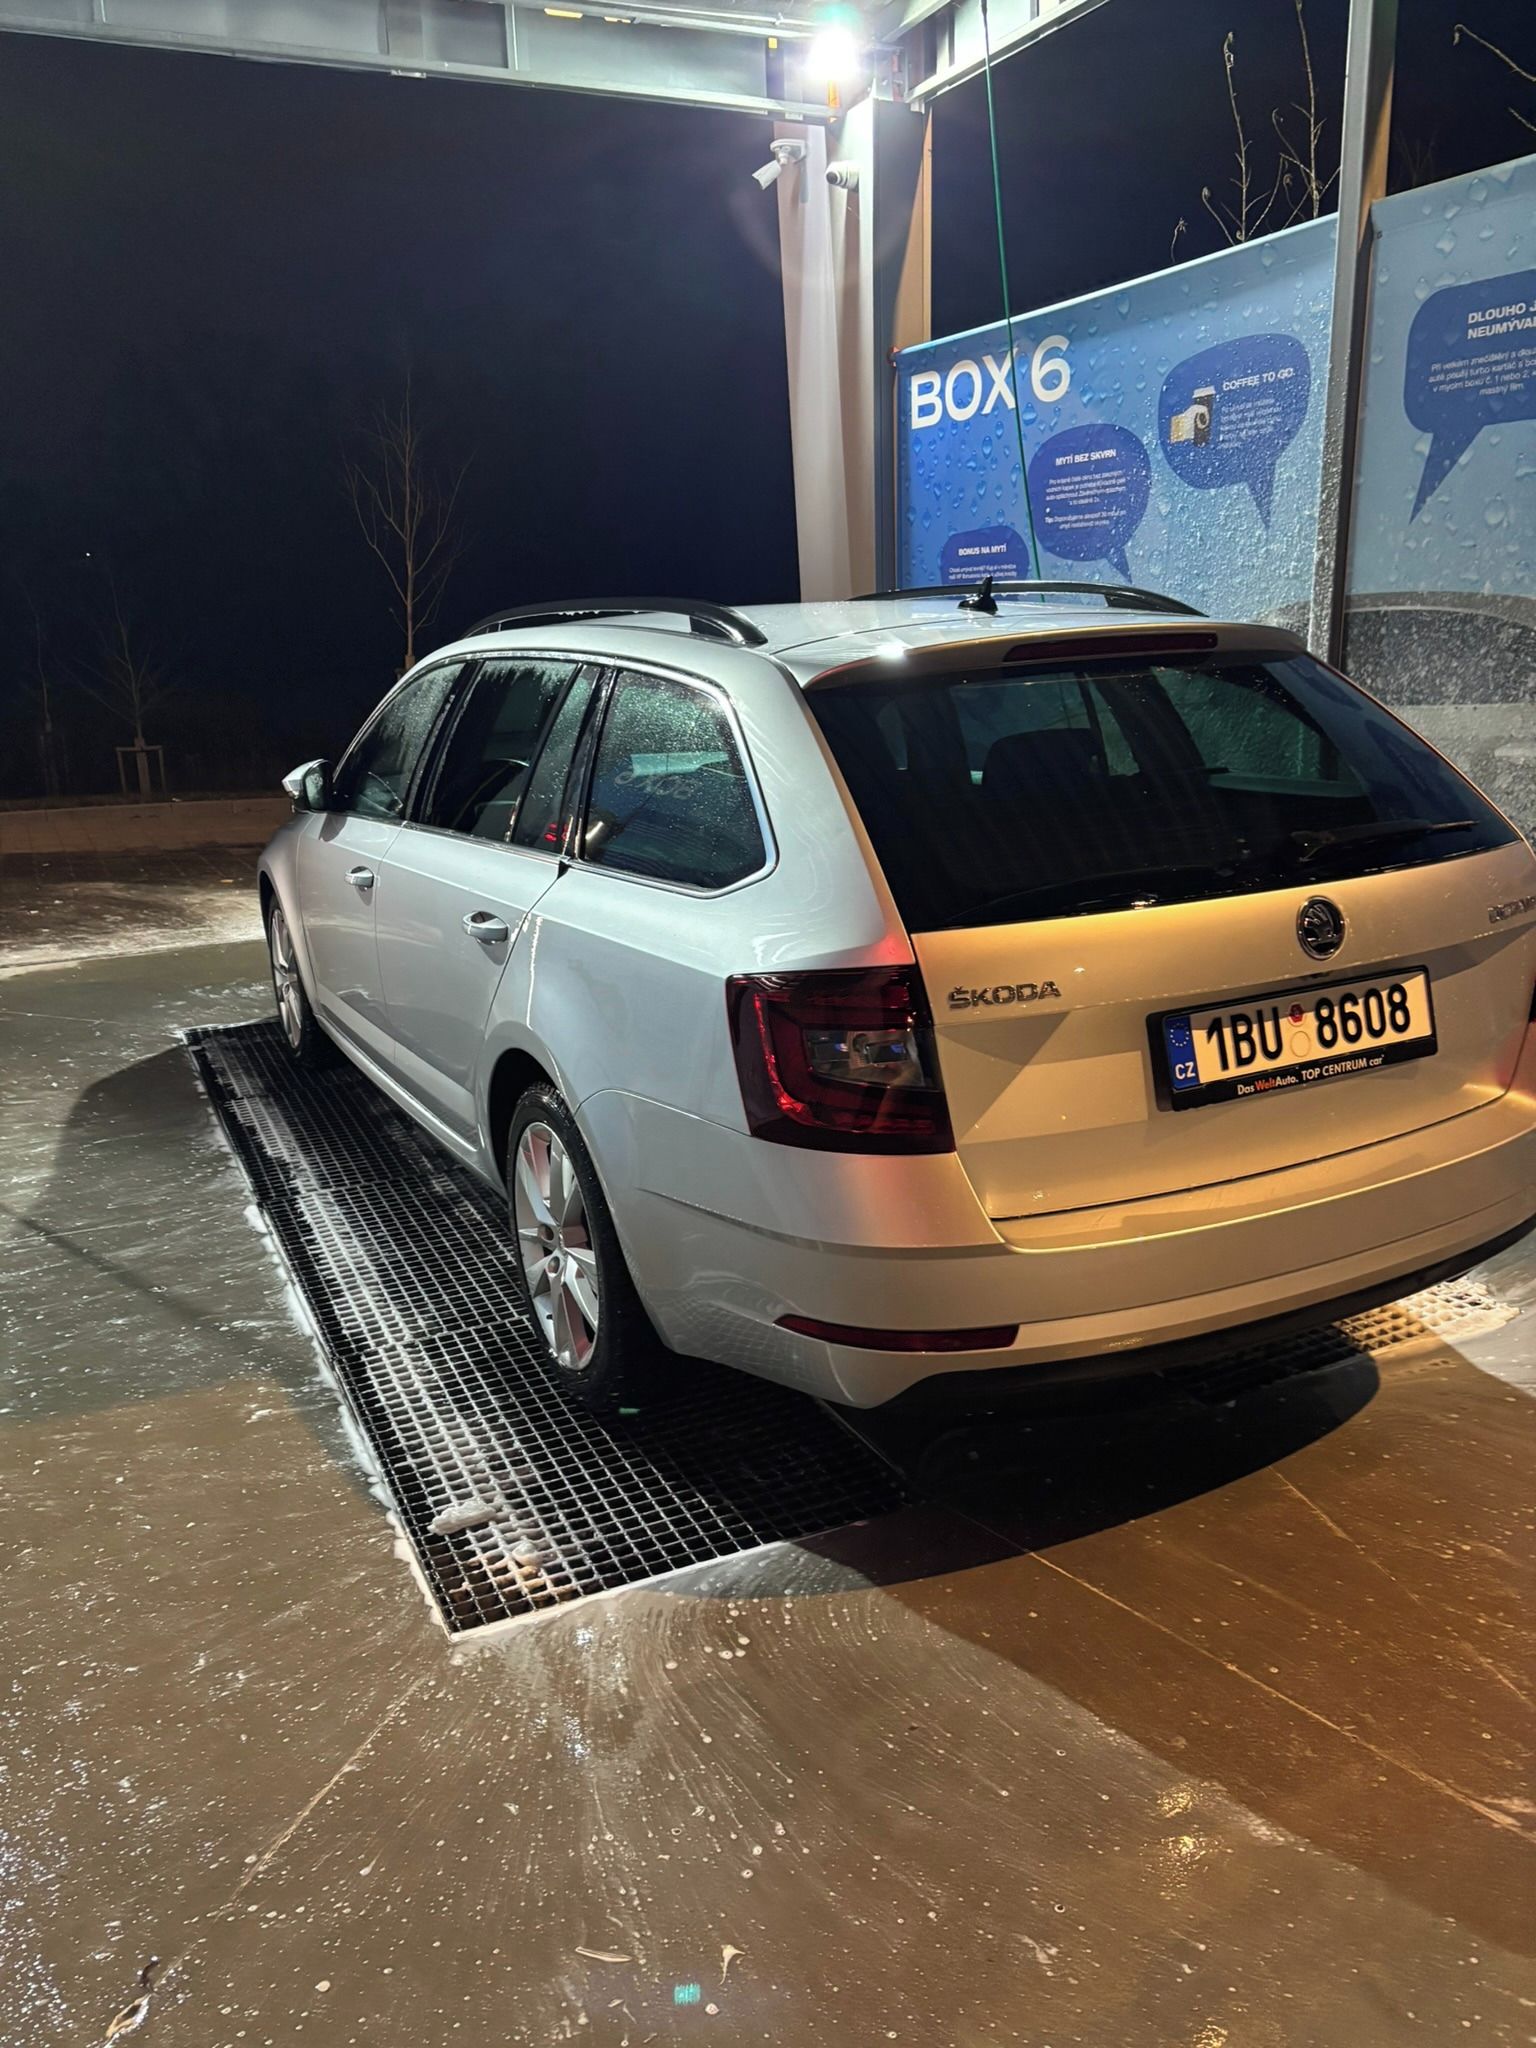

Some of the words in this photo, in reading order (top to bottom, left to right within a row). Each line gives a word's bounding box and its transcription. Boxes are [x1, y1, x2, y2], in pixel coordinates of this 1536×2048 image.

[1468, 303, 1526, 324] DLOUHO
[911, 347, 1019, 429] BOX
[1031, 334, 1070, 402] 6
[1222, 374, 1260, 391] COFFEE
[1262, 371, 1276, 383] TO
[1056, 454, 1073, 466] MYTÍ
[1075, 453, 1090, 464] BEZ
[1091, 448, 1117, 461] SKVRN
[958, 546, 980, 556] BONUS
[981, 546, 990, 554] NA
[991, 542, 1007, 553] MYTÍ
[948, 981, 1061, 1010] ŠKODA
[1206, 1007, 1283, 1072] 1BU
[1315, 983, 1411, 1049] 8608
[1175, 1061, 1196, 1080] CZ
[1237, 1084, 1255, 1095] Das
[1301, 1068, 1321, 1081] TOP
[1322, 1057, 1367, 1077] CENTRUM
